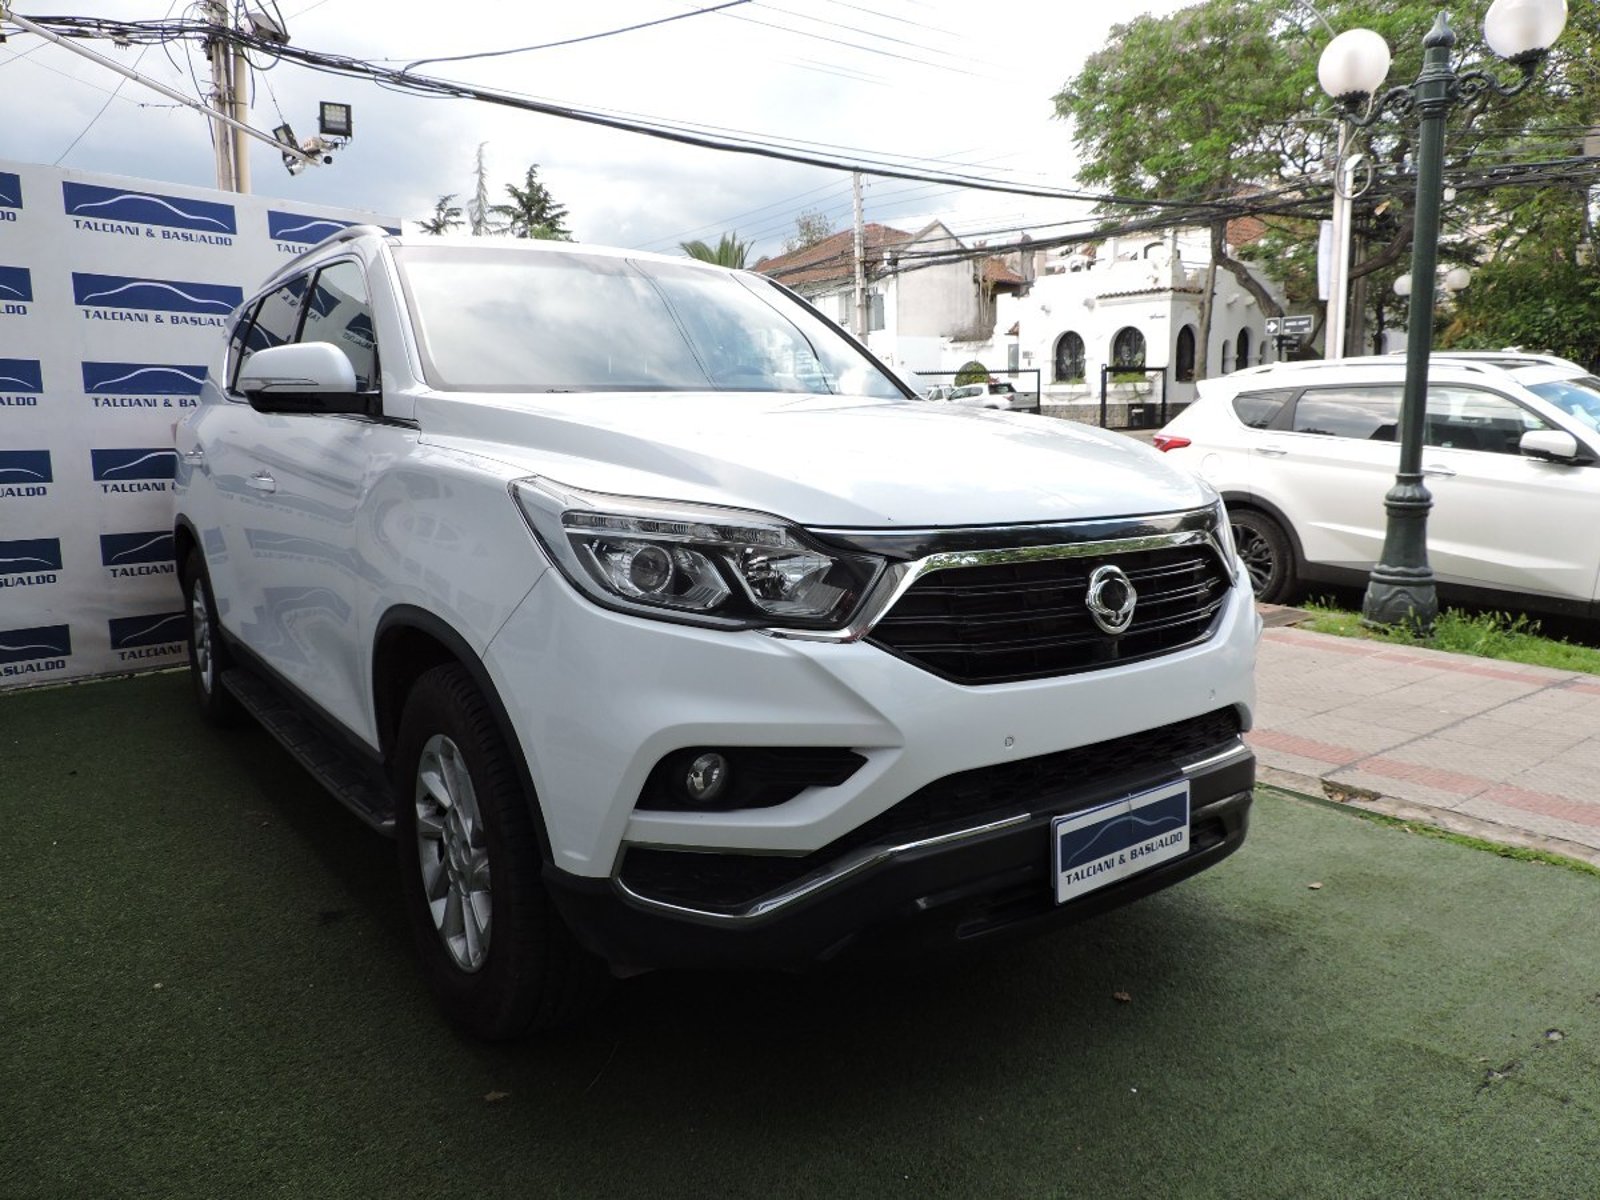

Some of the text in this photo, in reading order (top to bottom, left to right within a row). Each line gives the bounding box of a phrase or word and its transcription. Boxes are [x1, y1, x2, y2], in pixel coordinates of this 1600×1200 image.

[73, 219, 233, 246] TALCIANI & BASUALDO
[83, 309, 226, 328] TALCIANI & BASUAL
[92, 397, 158, 408] TALCIANI
[163, 398, 173, 408] &
[101, 482, 166, 494] TALCIANI
[110, 563, 175, 578] TALCIANI
[118, 644, 182, 661] TALCIANI
[1065, 831, 1183, 885] TALCIANI & BASUALDO
